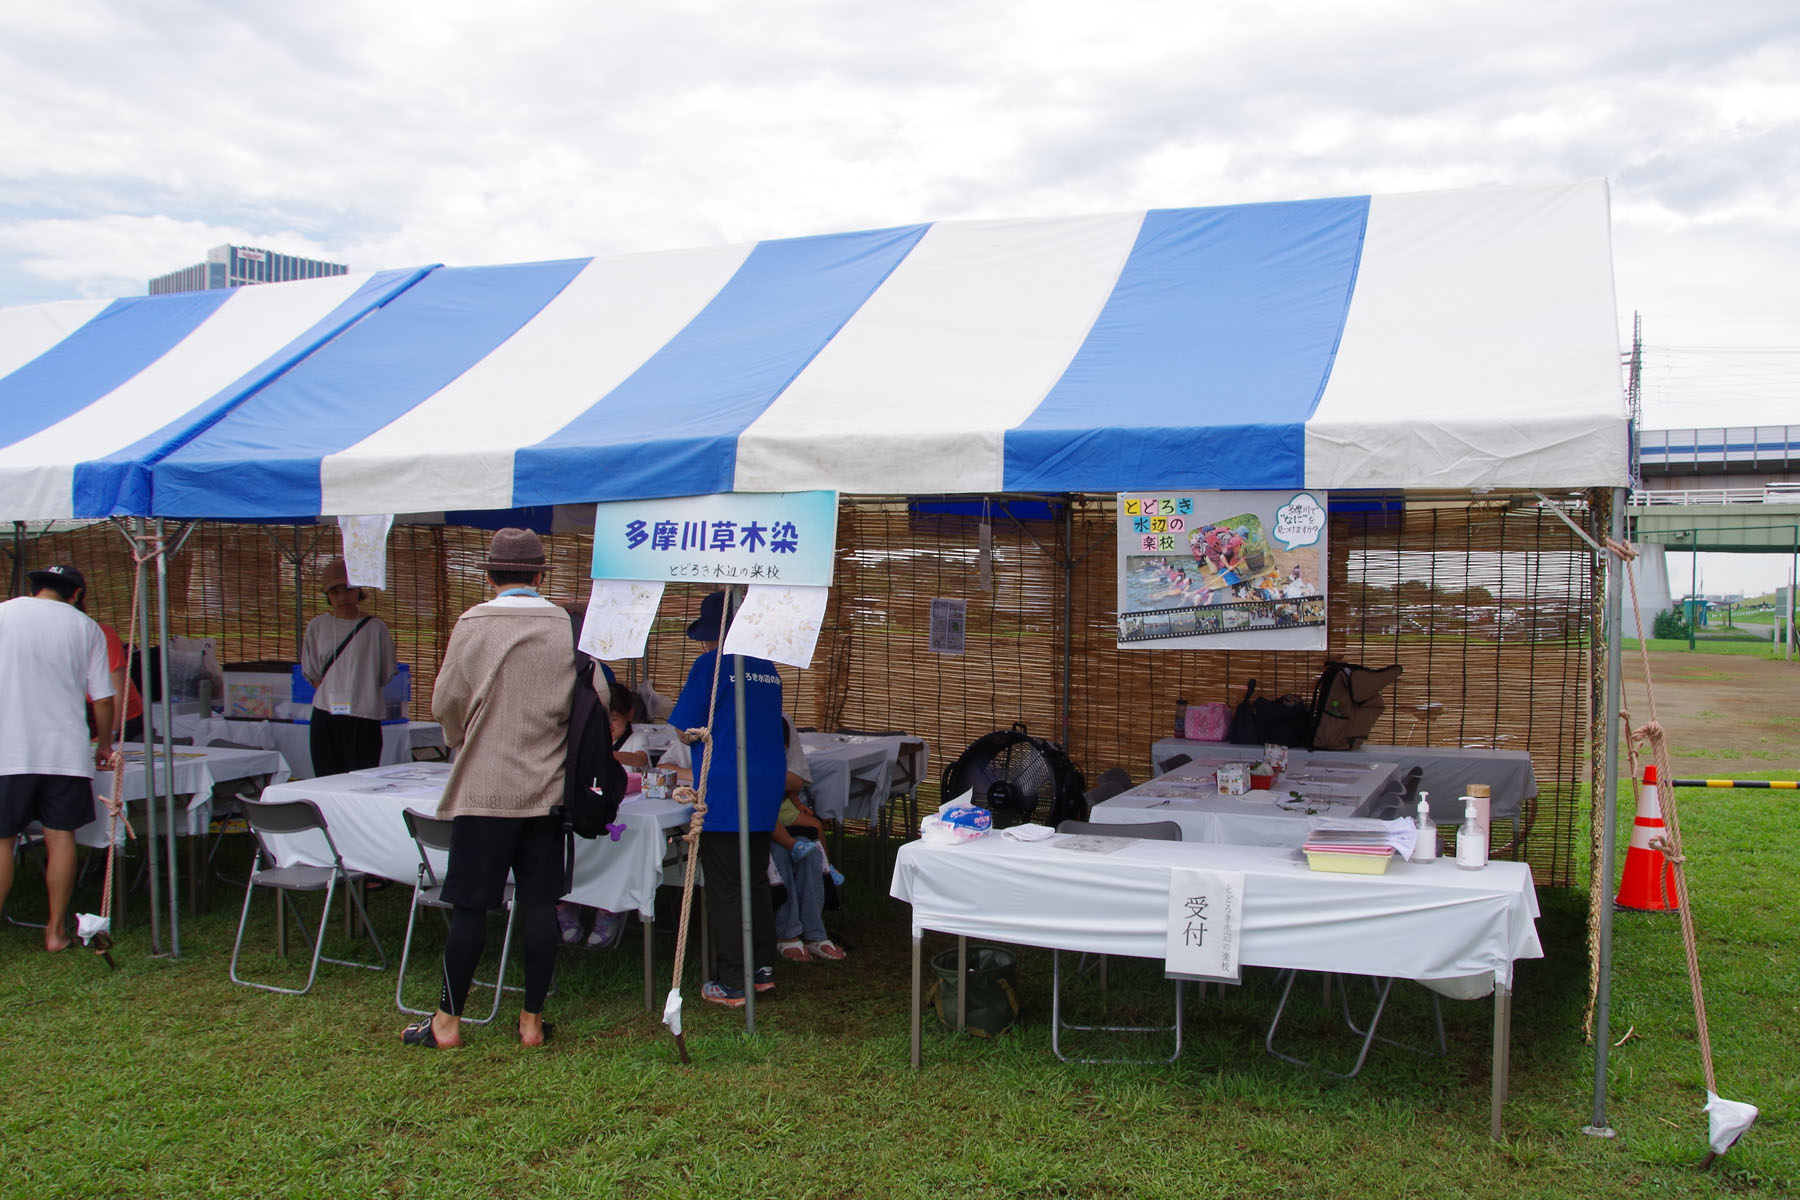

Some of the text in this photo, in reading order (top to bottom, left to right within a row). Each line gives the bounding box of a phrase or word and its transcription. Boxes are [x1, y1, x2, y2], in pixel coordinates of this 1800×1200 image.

[1125, 498, 1193, 515] とどろき
[1134, 516, 1184, 533] 水辺の
[624, 519, 799, 554] 多摩川草木染
[1142, 535, 1175, 551] 楽校
[669, 562, 780, 580] とどろき水辺の楽校
[1183, 895, 1208, 947] 受付
